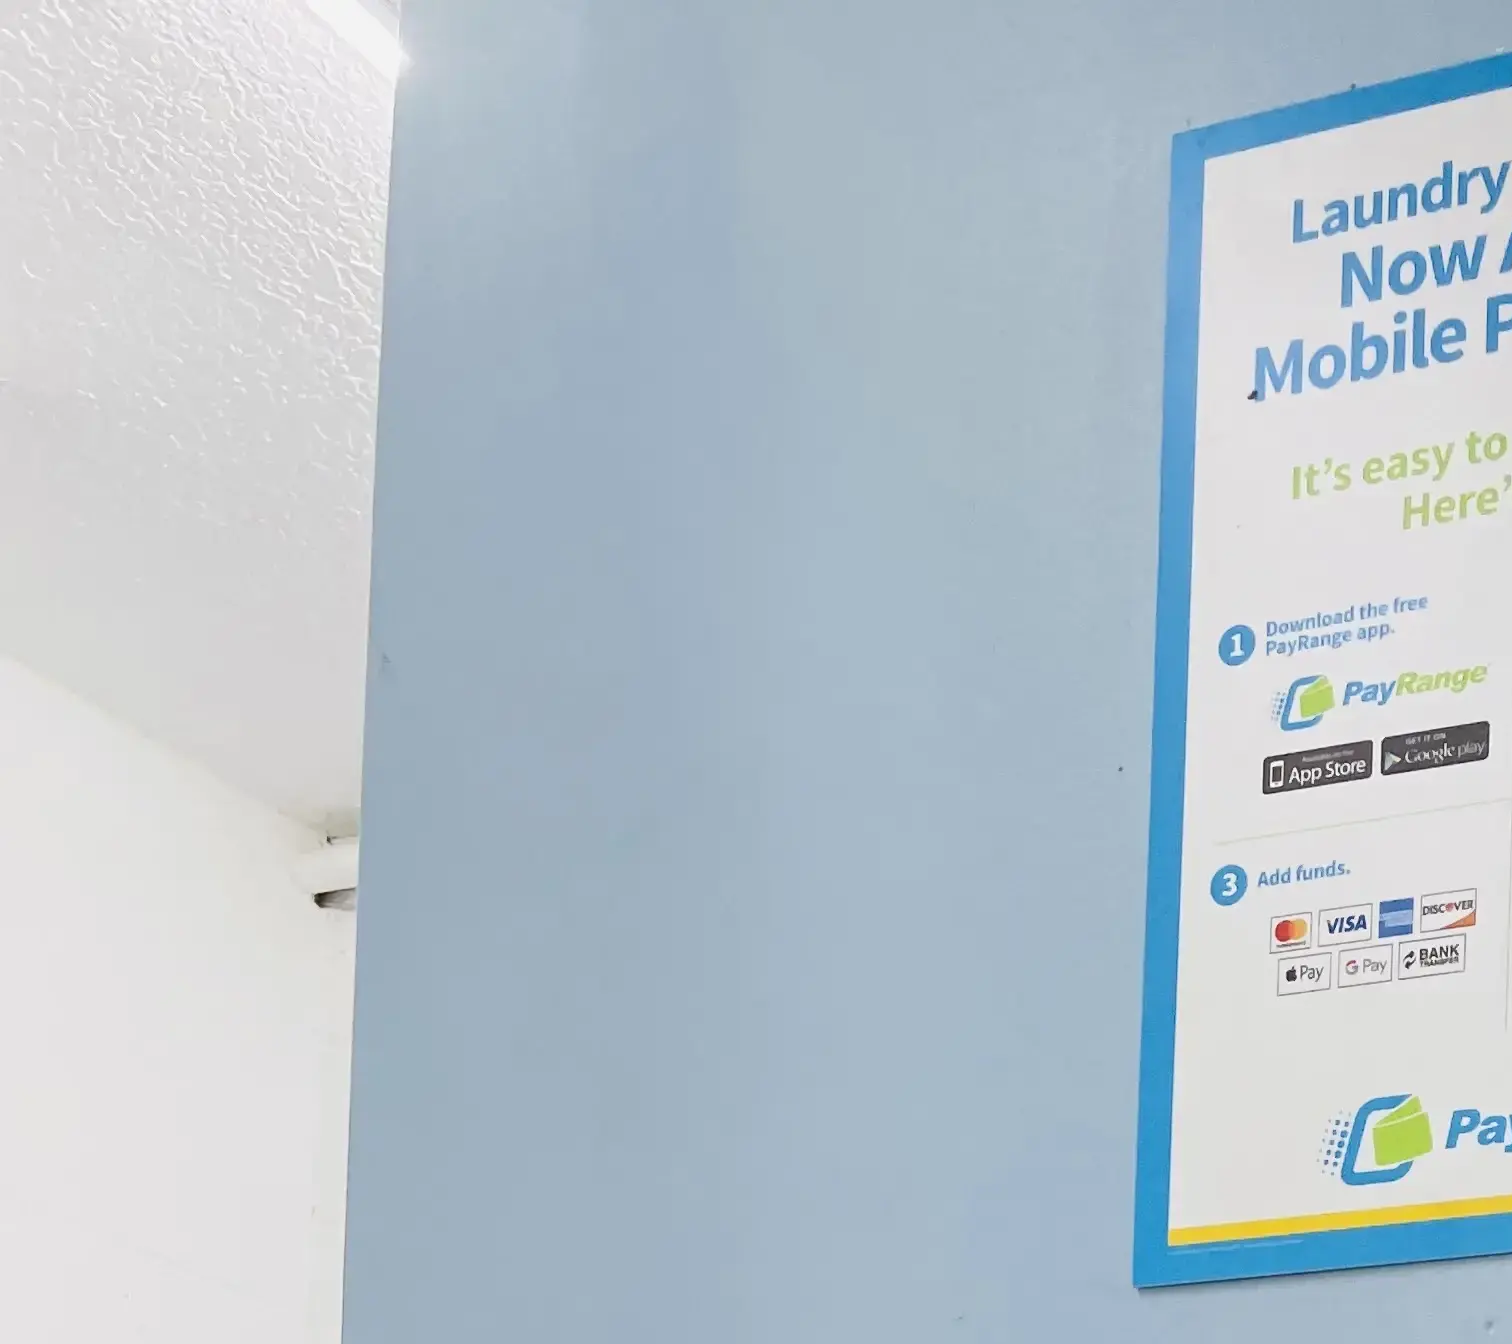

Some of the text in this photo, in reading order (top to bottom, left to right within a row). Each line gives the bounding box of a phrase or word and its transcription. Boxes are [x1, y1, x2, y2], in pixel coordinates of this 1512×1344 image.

[1291, 161, 1512, 244] Laundry
[1338, 236, 1487, 307] Now
[1253, 312, 1466, 400] Mobile
[1291, 457, 1351, 500] It's
[1361, 438, 1455, 487] easy
[1464, 426, 1507, 465] to
[1266, 596, 1429, 636] Download the free
[1230, 634, 1245, 656] 1
[1266, 622, 1395, 656] PayRange app.
[1342, 664, 1488, 706] PayRange
[1405, 741, 1486, 764] Google play
[1288, 759, 1367, 786] App Store
[1221, 873, 1238, 897] 3
[1257, 860, 1351, 887] Add funds.
[1422, 900, 1474, 915] DISCOVER
[1326, 914, 1368, 934] VISA
[1419, 944, 1460, 961] BANK
[1299, 965, 1325, 982] Pay
[1362, 958, 1388, 975] Pay
